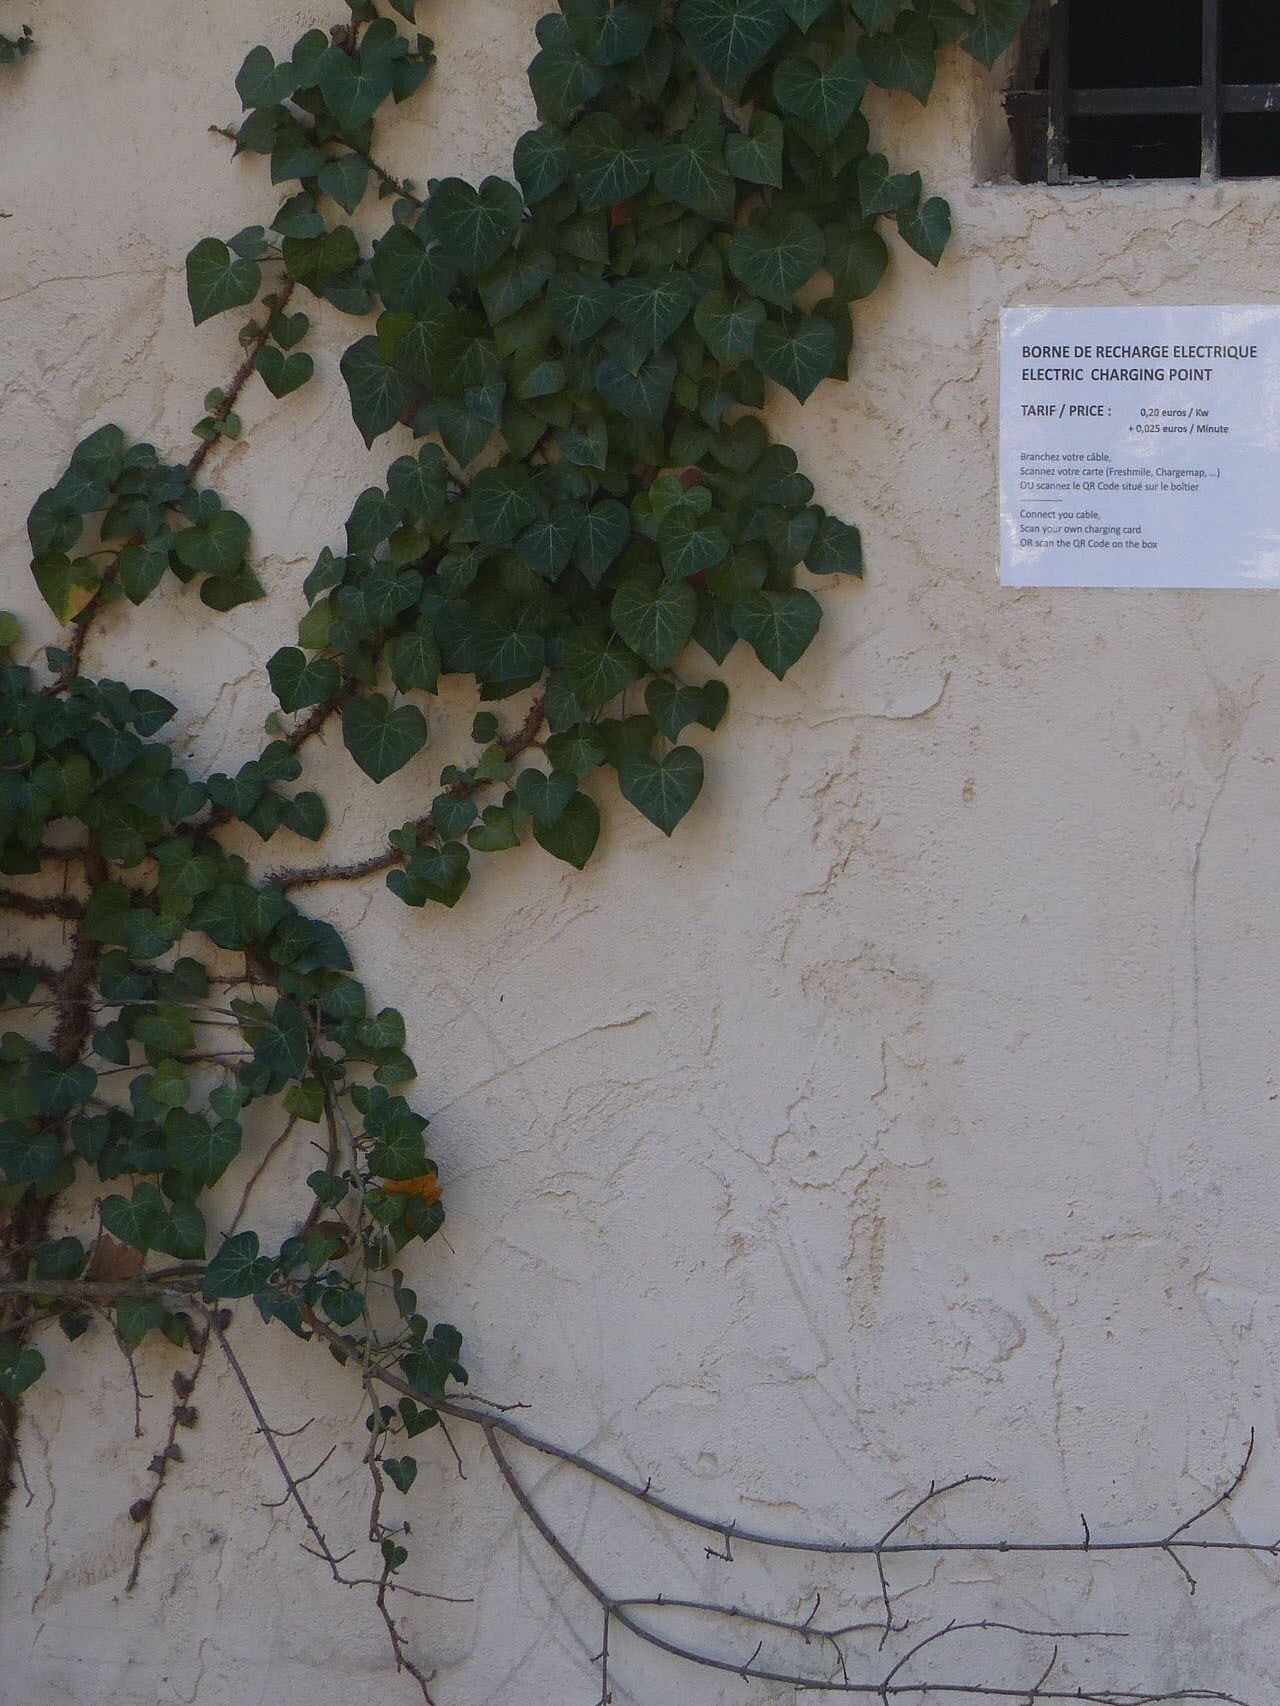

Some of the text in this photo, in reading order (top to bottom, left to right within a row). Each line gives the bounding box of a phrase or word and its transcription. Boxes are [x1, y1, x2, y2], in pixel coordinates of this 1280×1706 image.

[1022, 346, 1257, 359] BORNE DE RECHARGE ELECTRIQUE
[1022, 368, 1213, 381] ELECTRIC CHARGING POINT
[1021, 405, 1056, 417] TARIF
[1059, 404, 1066, 418] /
[1069, 405, 1104, 417] PRICE
[1161, 409, 1186, 417] euros
[1188, 408, 1193, 418] /
[1195, 408, 1209, 417] Kw
[1136, 424, 1160, 434] 0,025
[1189, 424, 1194, 434] /
[1196, 424, 1229, 433] Minute
[1020, 453, 1059, 461] Branchez
[1062, 453, 1084, 461] votre
[1020, 467, 1055, 476] Scannez
[1058, 468, 1080, 476] votre
[1082, 468, 1104, 476] carte
[1156, 468, 1207, 478] Chargemap,
[1020, 481, 1034, 490] OU
[1036, 482, 1070, 490] scannez
[1073, 482, 1080, 490] le
[1083, 482, 1095, 491] QR
[1098, 482, 1119, 490] Code
[1122, 482, 1142, 491] situé
[1161, 482, 1168, 491] le
[1020, 510, 1101, 520] Connect you cable,
[1020, 524, 1040, 533] Scan
[1042, 526, 1062, 535] your
[1085, 525, 1120, 535] charging
[1123, 525, 1141, 534] card
[1020, 539, 1033, 547] OR
[1035, 540, 1054, 548] scan
[1057, 539, 1071, 548] the
[1073, 539, 1086, 548] QR
[1088, 540, 1110, 548] Code
[1126, 540, 1139, 548] the
[1142, 540, 1158, 549] box
